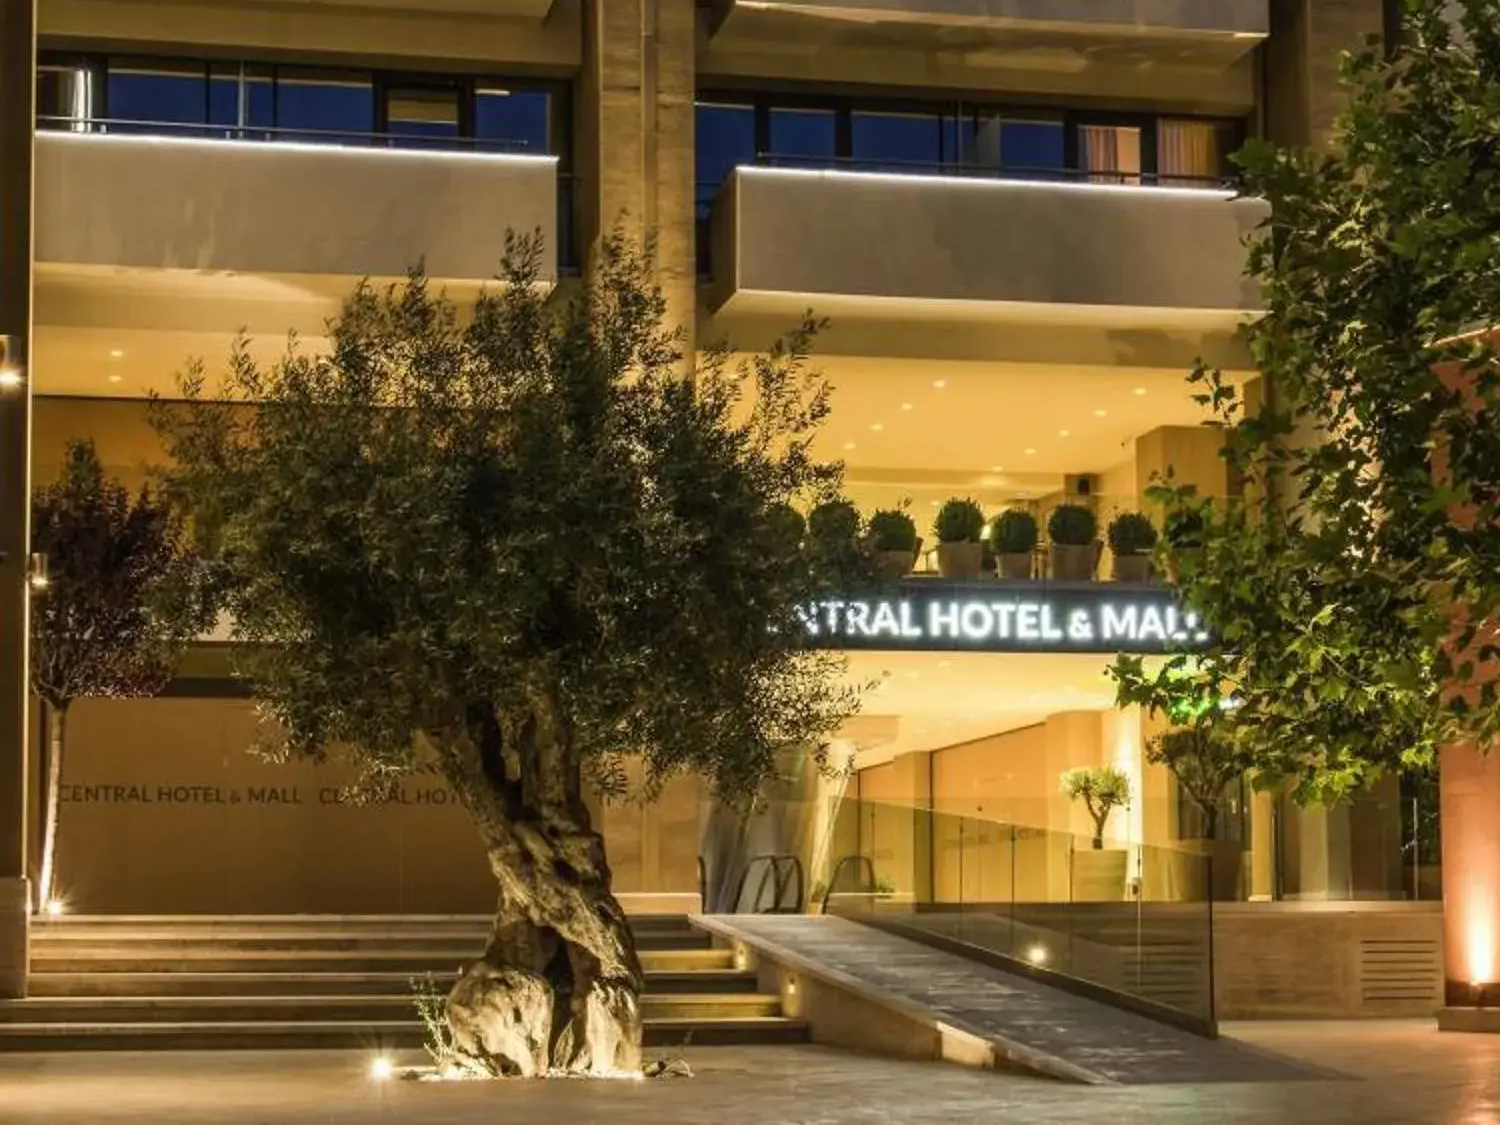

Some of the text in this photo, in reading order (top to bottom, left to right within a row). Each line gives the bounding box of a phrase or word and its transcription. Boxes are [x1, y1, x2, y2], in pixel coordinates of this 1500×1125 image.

[929, 602, 1062, 639] HOTEL
[1069, 608, 1094, 639] &
[60, 784, 152, 803] CENTRAL
[157, 785, 226, 804] HOTEL
[246, 786, 303, 805] MALL
